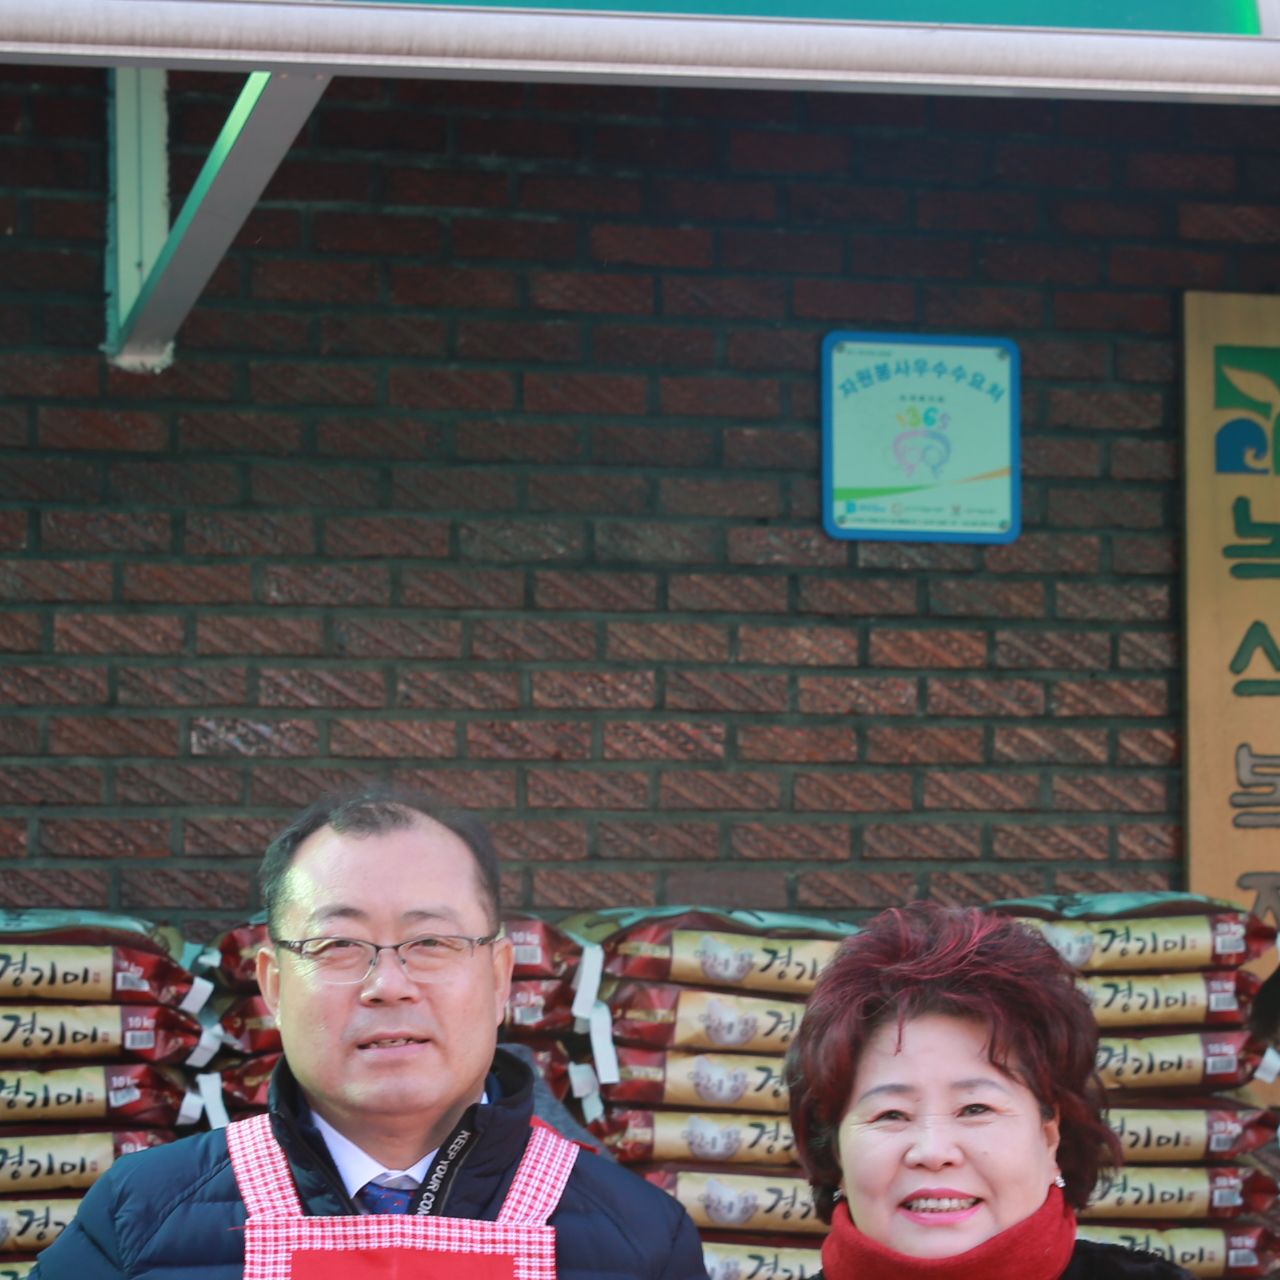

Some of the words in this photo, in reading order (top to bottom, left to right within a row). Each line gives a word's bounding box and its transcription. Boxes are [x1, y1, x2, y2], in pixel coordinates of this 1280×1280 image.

[1097, 925, 1187, 957] 경기미
[759, 947, 818, 980] 경기
[1101, 980, 1188, 1013] 경기미
[1, 1010, 99, 1048] 경기미
[1098, 1044, 1184, 1077] 경기미
[446, 1129, 472, 1161] KEEP
[426, 1158, 452, 1193] YOUR
